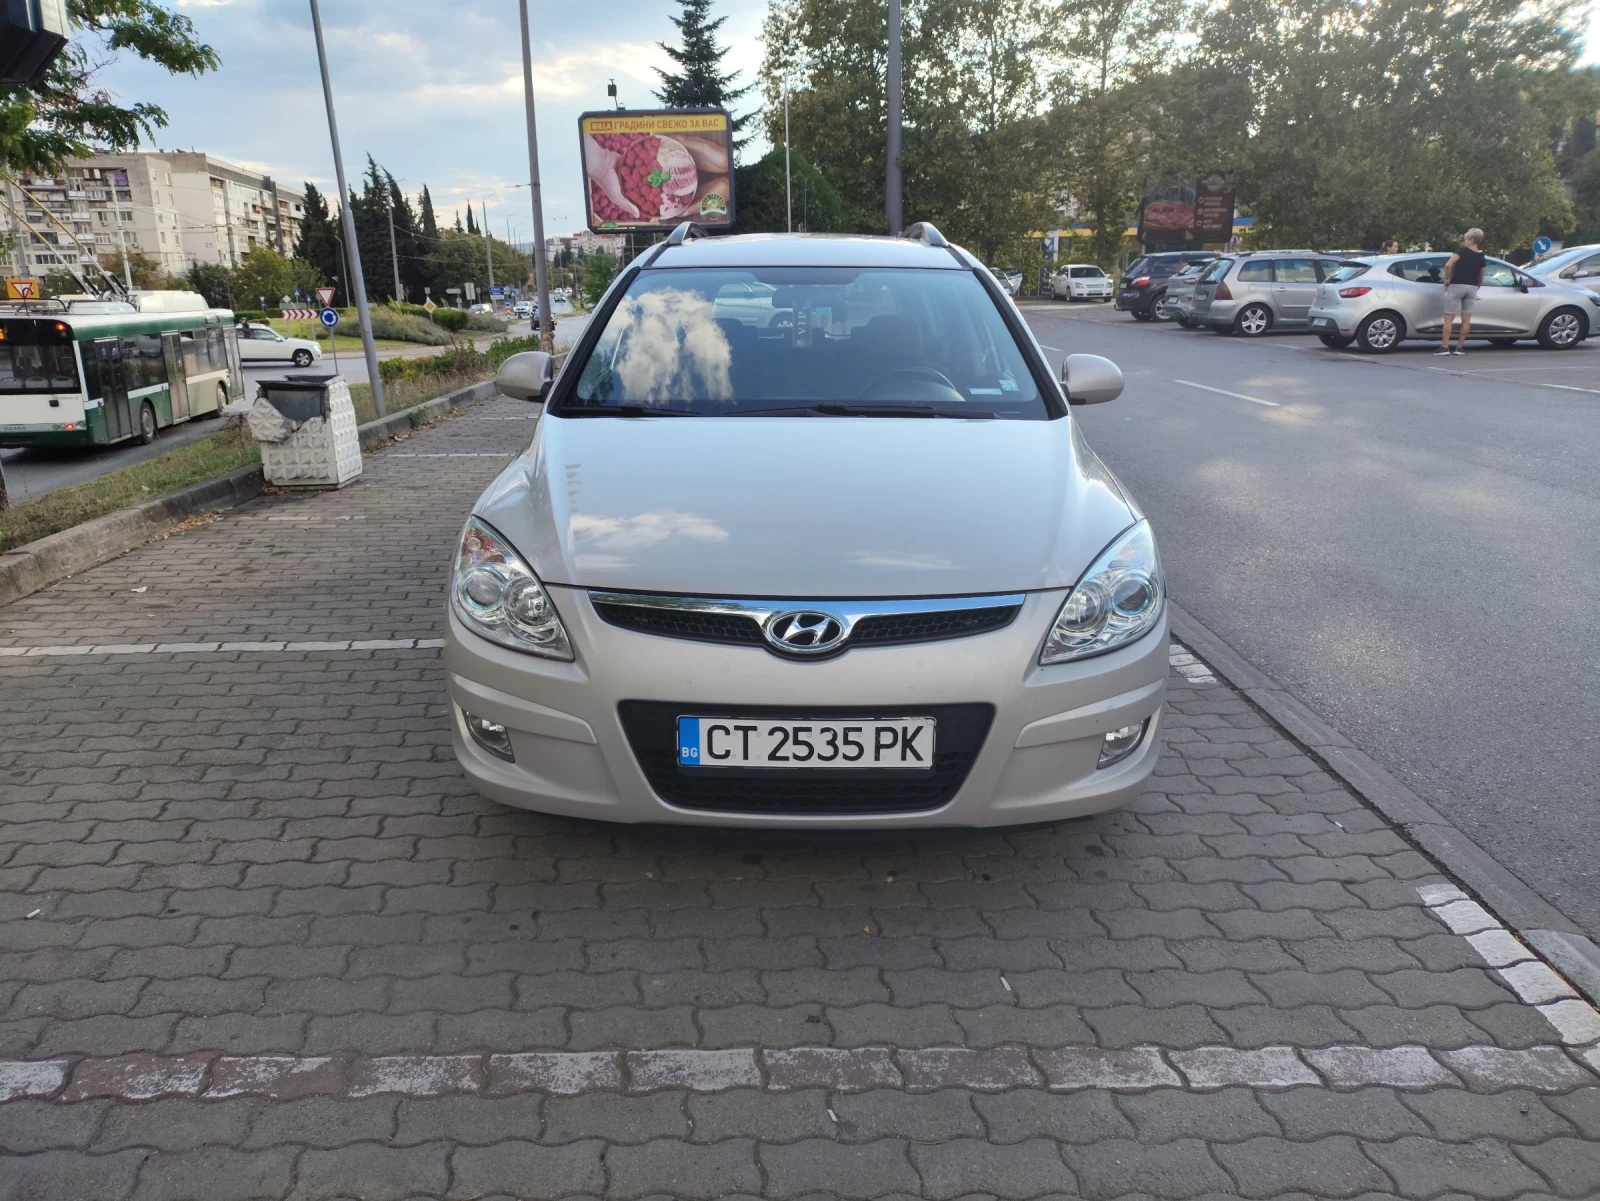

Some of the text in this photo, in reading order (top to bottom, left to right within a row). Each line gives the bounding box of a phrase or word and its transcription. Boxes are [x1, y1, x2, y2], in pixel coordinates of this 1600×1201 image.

[614, 119, 719, 130] ГРАДИНИ СВЕЖО ЗА ВАС
[798, 311, 806, 335] VIP
[706, 724, 924, 762] CT 2535 PK
[682, 747, 698, 758] BG
